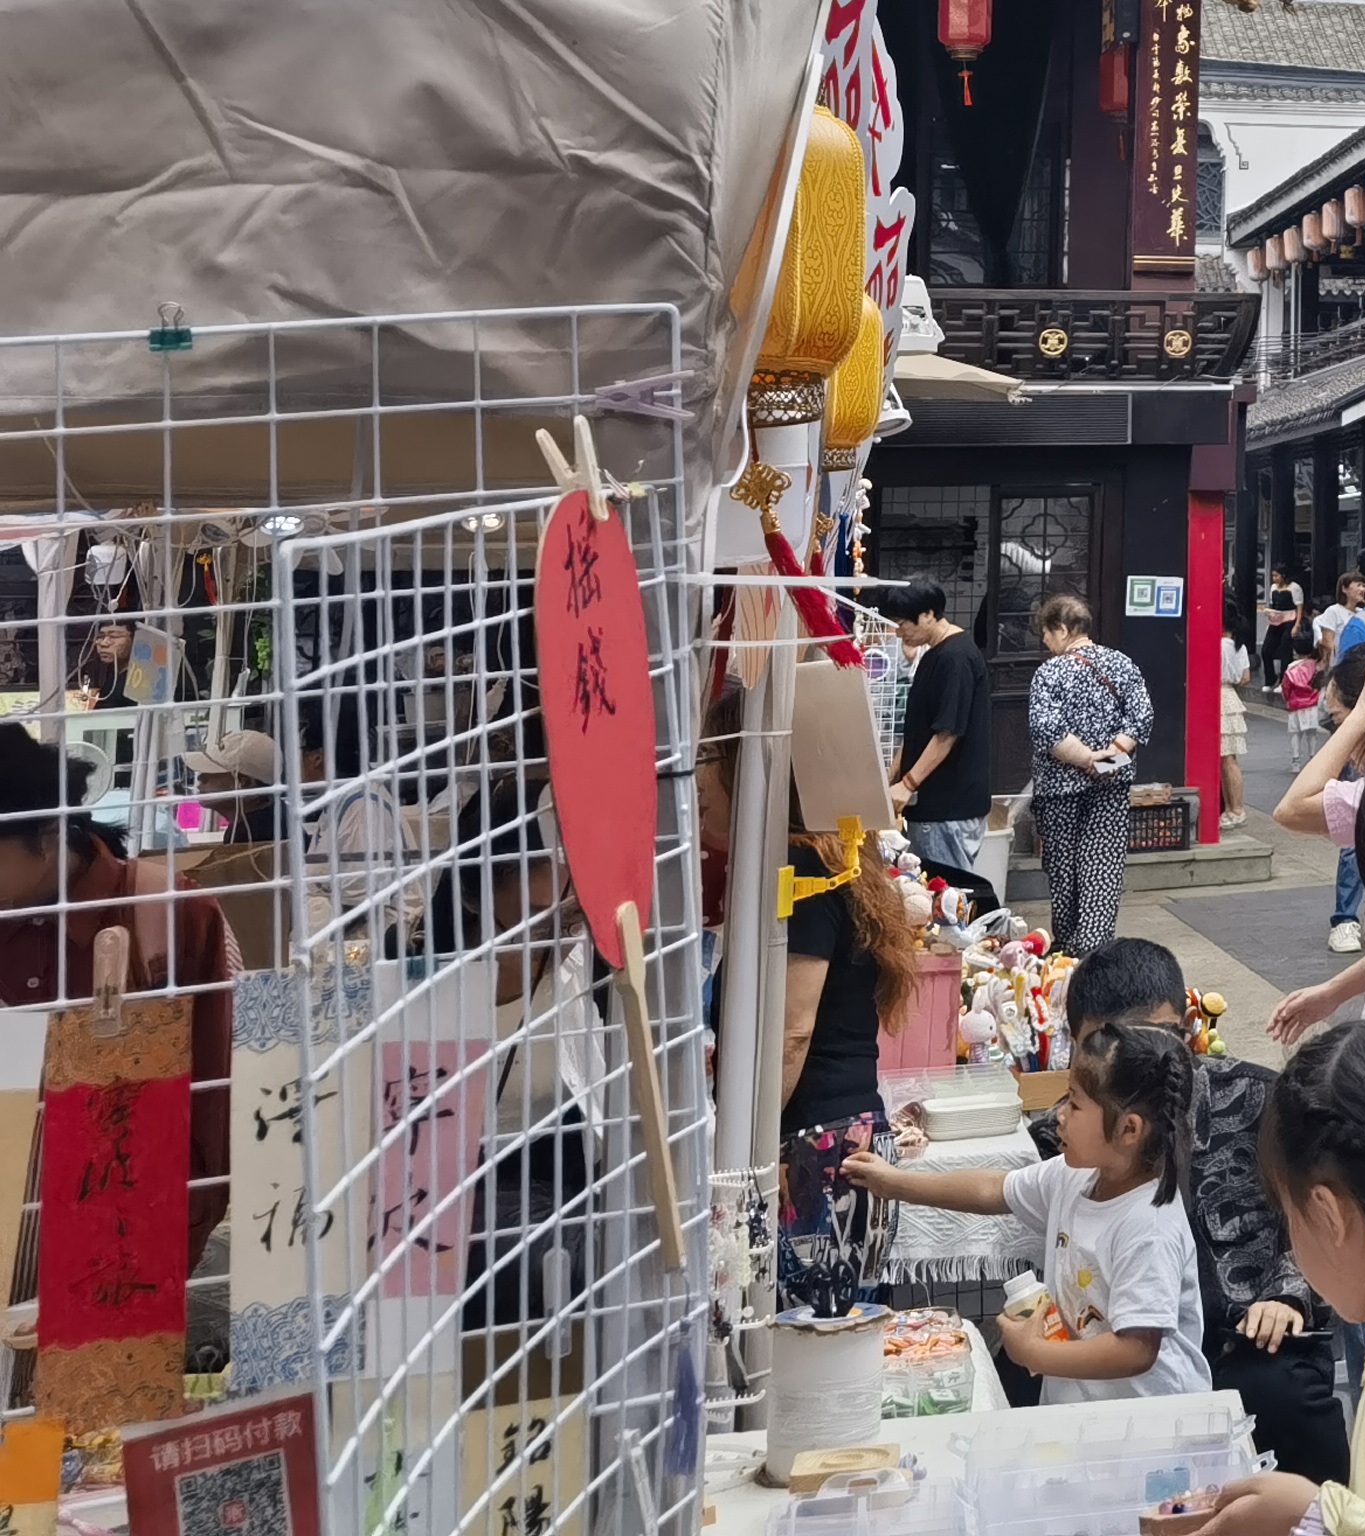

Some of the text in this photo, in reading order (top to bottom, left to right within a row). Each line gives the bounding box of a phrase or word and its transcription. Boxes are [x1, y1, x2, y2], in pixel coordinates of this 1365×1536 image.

[150, 1410, 303, 1472] 请扫码付款
